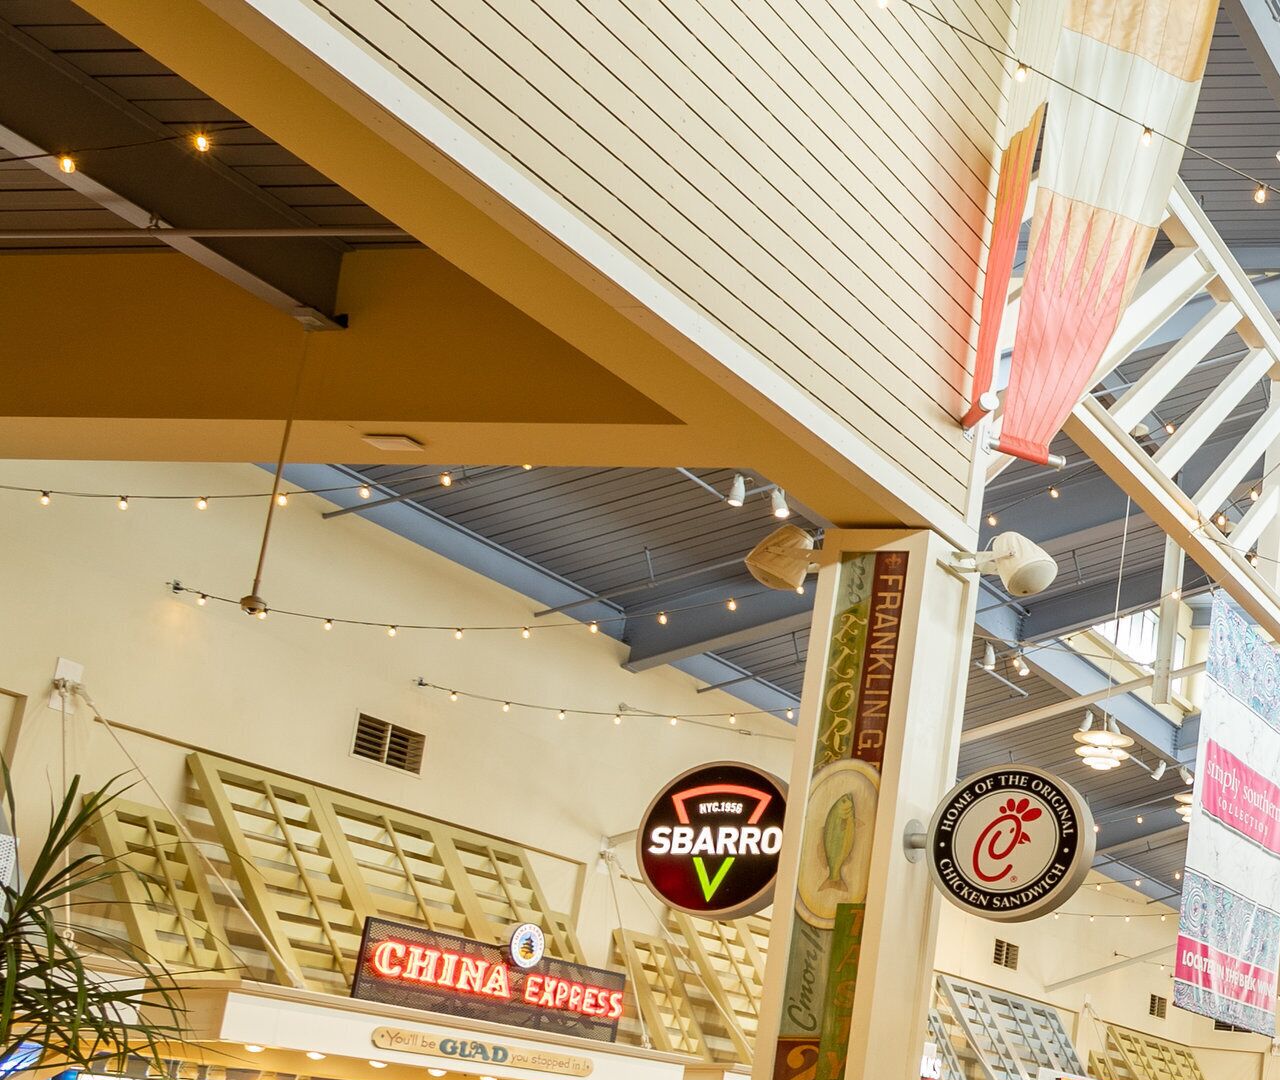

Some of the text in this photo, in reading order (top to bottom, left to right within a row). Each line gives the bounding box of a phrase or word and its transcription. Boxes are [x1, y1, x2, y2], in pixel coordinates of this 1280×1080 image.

[863, 574, 904, 717] FRANKLIN
[1206, 755, 1241, 800] simply
[940, 775, 1074, 838] HOME OF THE ORIGINAL
[648, 826, 783, 855] SBARRO
[939, 858, 1066, 909] CHICKEN SANDWICH
[373, 940, 511, 999] CHINA
[523, 975, 625, 1020] EXPRESS
[386, 1029, 417, 1047] You'll
[421, 1036, 436, 1050] be
[439, 1037, 509, 1063] GLAD
[510, 1052, 528, 1066] you
[531, 1055, 569, 1071] stopped
